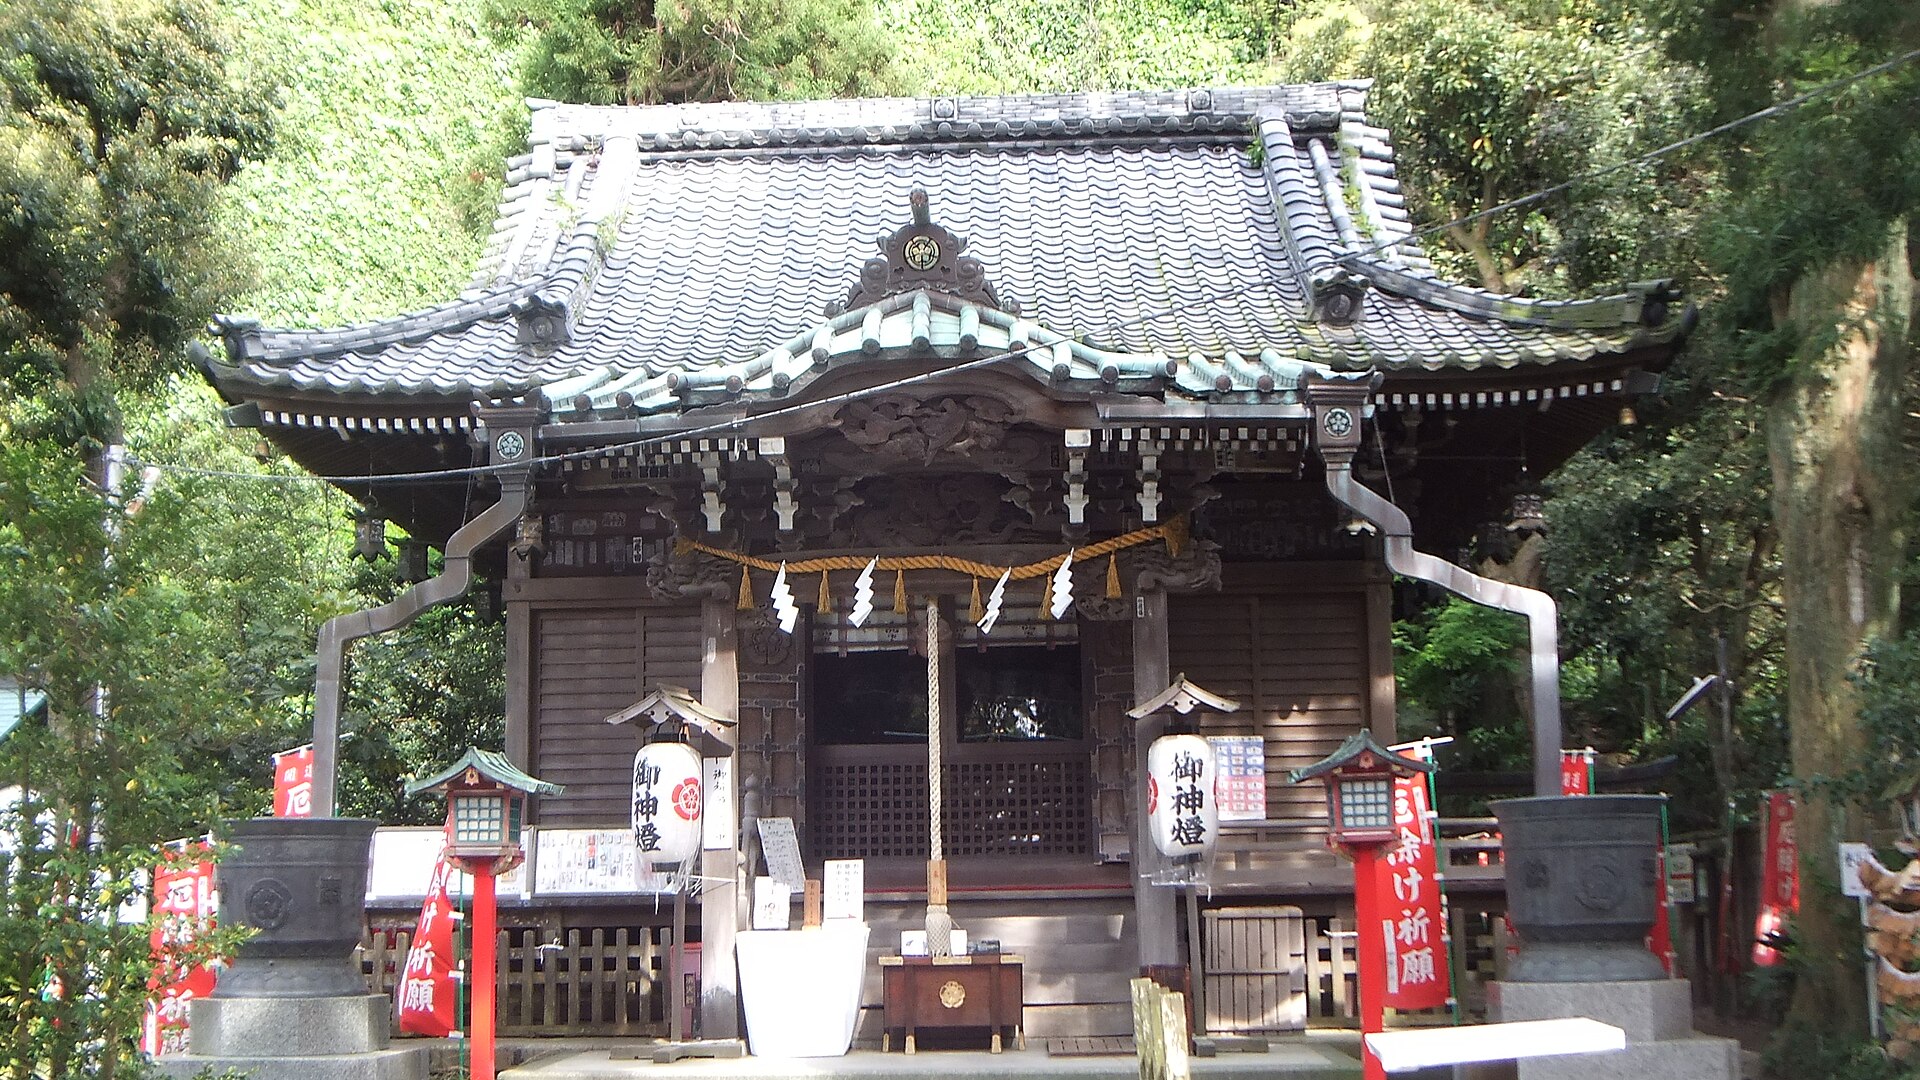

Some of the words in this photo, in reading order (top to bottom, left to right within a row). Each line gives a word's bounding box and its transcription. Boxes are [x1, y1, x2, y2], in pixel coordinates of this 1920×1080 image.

[633, 757, 662, 852] 御神燈
[1169, 751, 1206, 845] 御神燈
